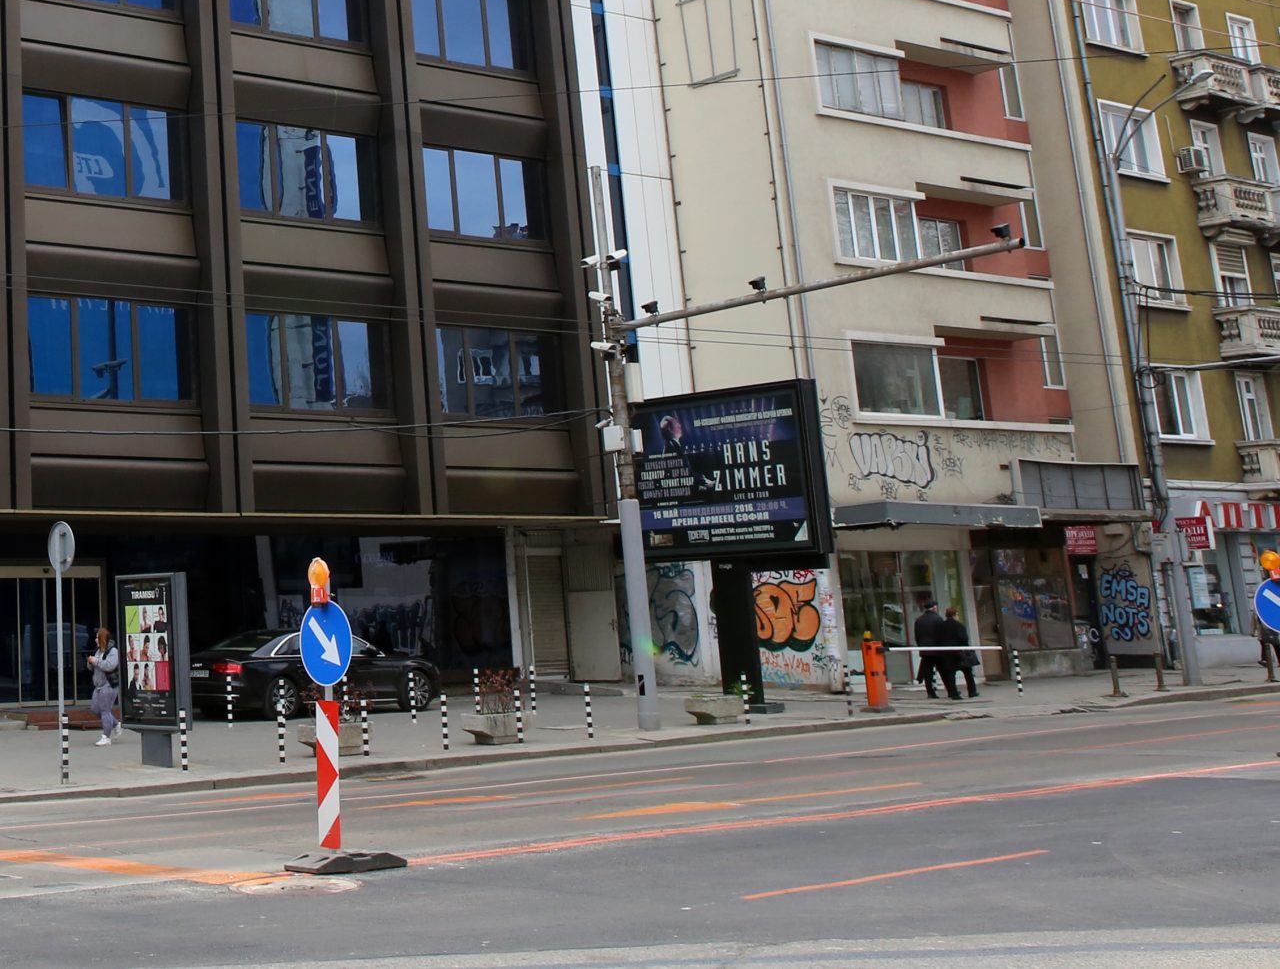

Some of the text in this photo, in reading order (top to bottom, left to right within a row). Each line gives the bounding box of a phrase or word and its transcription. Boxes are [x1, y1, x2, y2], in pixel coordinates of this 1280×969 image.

[723, 439, 770, 465] HANS
[713, 463, 787, 492] ZIMMER
[734, 491, 770, 501] LIVE ON TOUR
[653, 511, 662, 520] 16
[663, 508, 679, 519] МАЙ
[672, 511, 770, 527] АРЕНА АРМЕЕЦ СОФИЯ
[1194, 499, 1280, 529] АПТ
[131, 590, 155, 600] TIRAMISU
